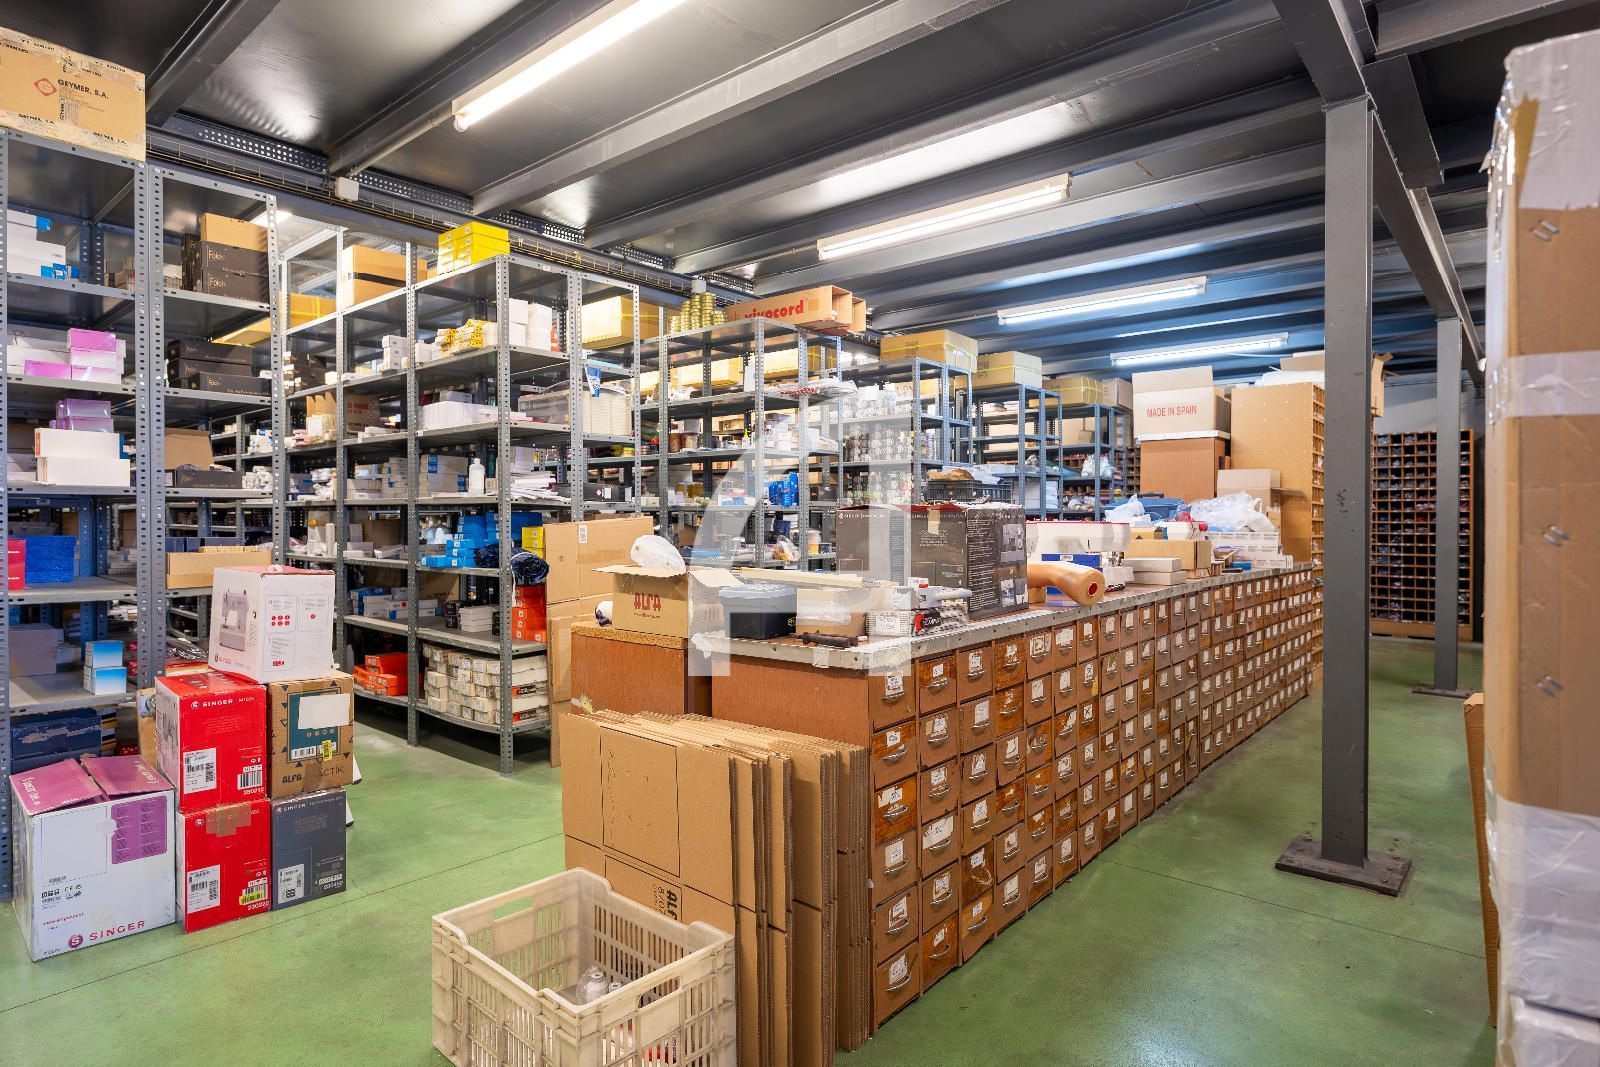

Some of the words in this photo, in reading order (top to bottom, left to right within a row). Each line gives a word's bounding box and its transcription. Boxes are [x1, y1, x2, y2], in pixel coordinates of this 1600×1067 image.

[58, 78, 92, 95] GEYMER,
[94, 89, 109, 99] S.A.
[1146, 407, 1166, 418] MADE
[1167, 406, 1175, 416] IN
[1176, 404, 1198, 416] SPAIN
[633, 592, 662, 612] ALFA
[202, 698, 233, 708] SINGER
[282, 773, 302, 784] ALFA
[666, 889, 678, 920] ALF
[89, 919, 146, 941] SINGER
